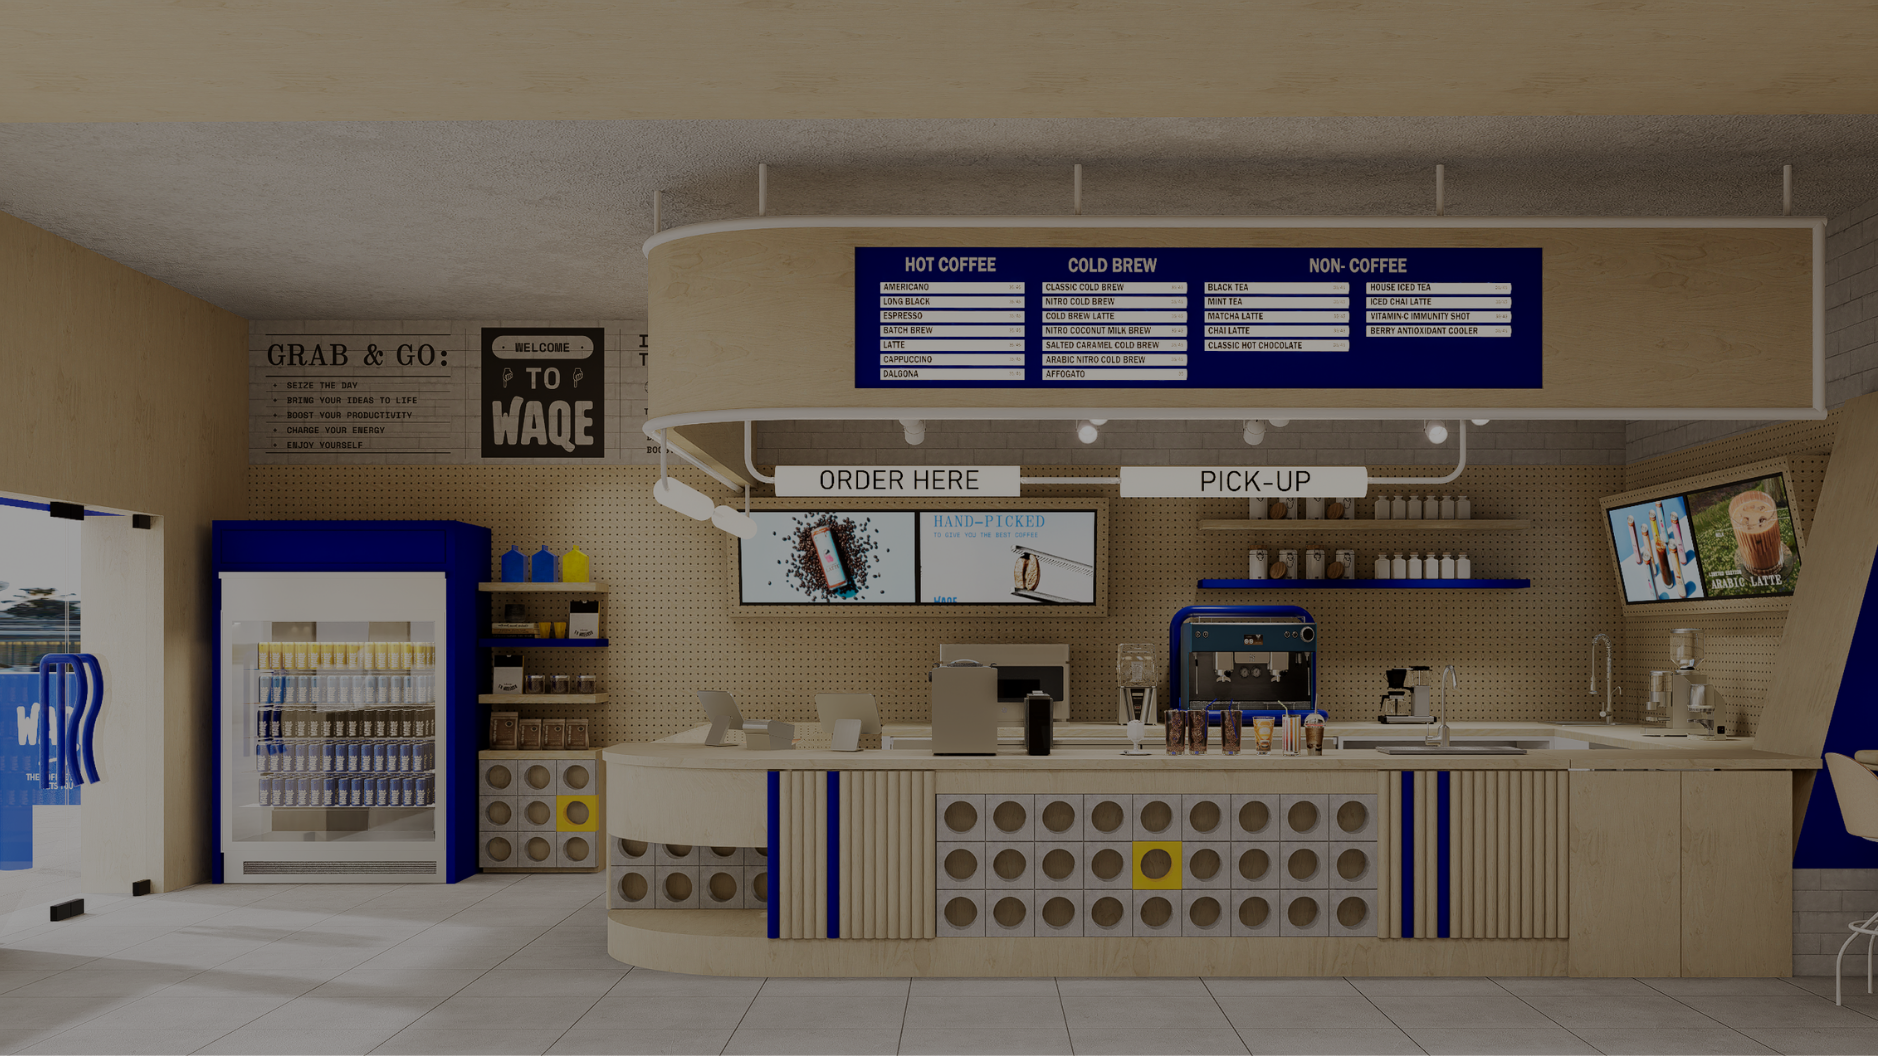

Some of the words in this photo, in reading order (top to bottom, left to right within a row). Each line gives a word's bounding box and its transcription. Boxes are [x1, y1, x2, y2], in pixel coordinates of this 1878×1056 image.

[906, 257, 934, 272] HOT
[938, 257, 996, 272] COFFEE
[1068, 258, 1108, 272] COLD
[1113, 258, 1157, 272] BREW
[1310, 258, 1345, 273] NON-
[1349, 258, 1407, 273] COFFEE
[516, 343, 569, 352] WELCOME
[267, 343, 348, 366] GRAB
[364, 344, 383, 365] &
[397, 344, 447, 366] GO:
[526, 367, 560, 389] TO
[884, 370, 918, 378] DALGONA
[1046, 370, 1085, 378] AFFOGATO
[286, 381, 314, 389] SEIZE
[319, 381, 336, 389] THE
[341, 381, 358, 389] DAY
[286, 396, 315, 404] BRING
[319, 396, 342, 404] YOUR
[347, 396, 374, 404] IDEAS
[379, 396, 391, 404] TO
[395, 396, 417, 404] LIFE
[286, 411, 314, 419] BOOST
[319, 411, 342, 419] YOUR
[346, 411, 413, 419] PRODUCTIVITY
[286, 426, 319, 434] CHARGE
[324, 426, 347, 434] YOUR
[352, 426, 385, 434] ENERGY
[492, 396, 593, 452] WAQE
[286, 441, 315, 449] ENJOY
[319, 441, 363, 449] YOURSELF
[820, 470, 903, 489] ORDER
[914, 470, 978, 489] HERE
[1202, 471, 1310, 491] PICK-UP
[935, 515, 1044, 527] HAND-PICKED
[1711, 577, 1745, 589] ARABIC
[1750, 574, 1783, 587] LATTE
